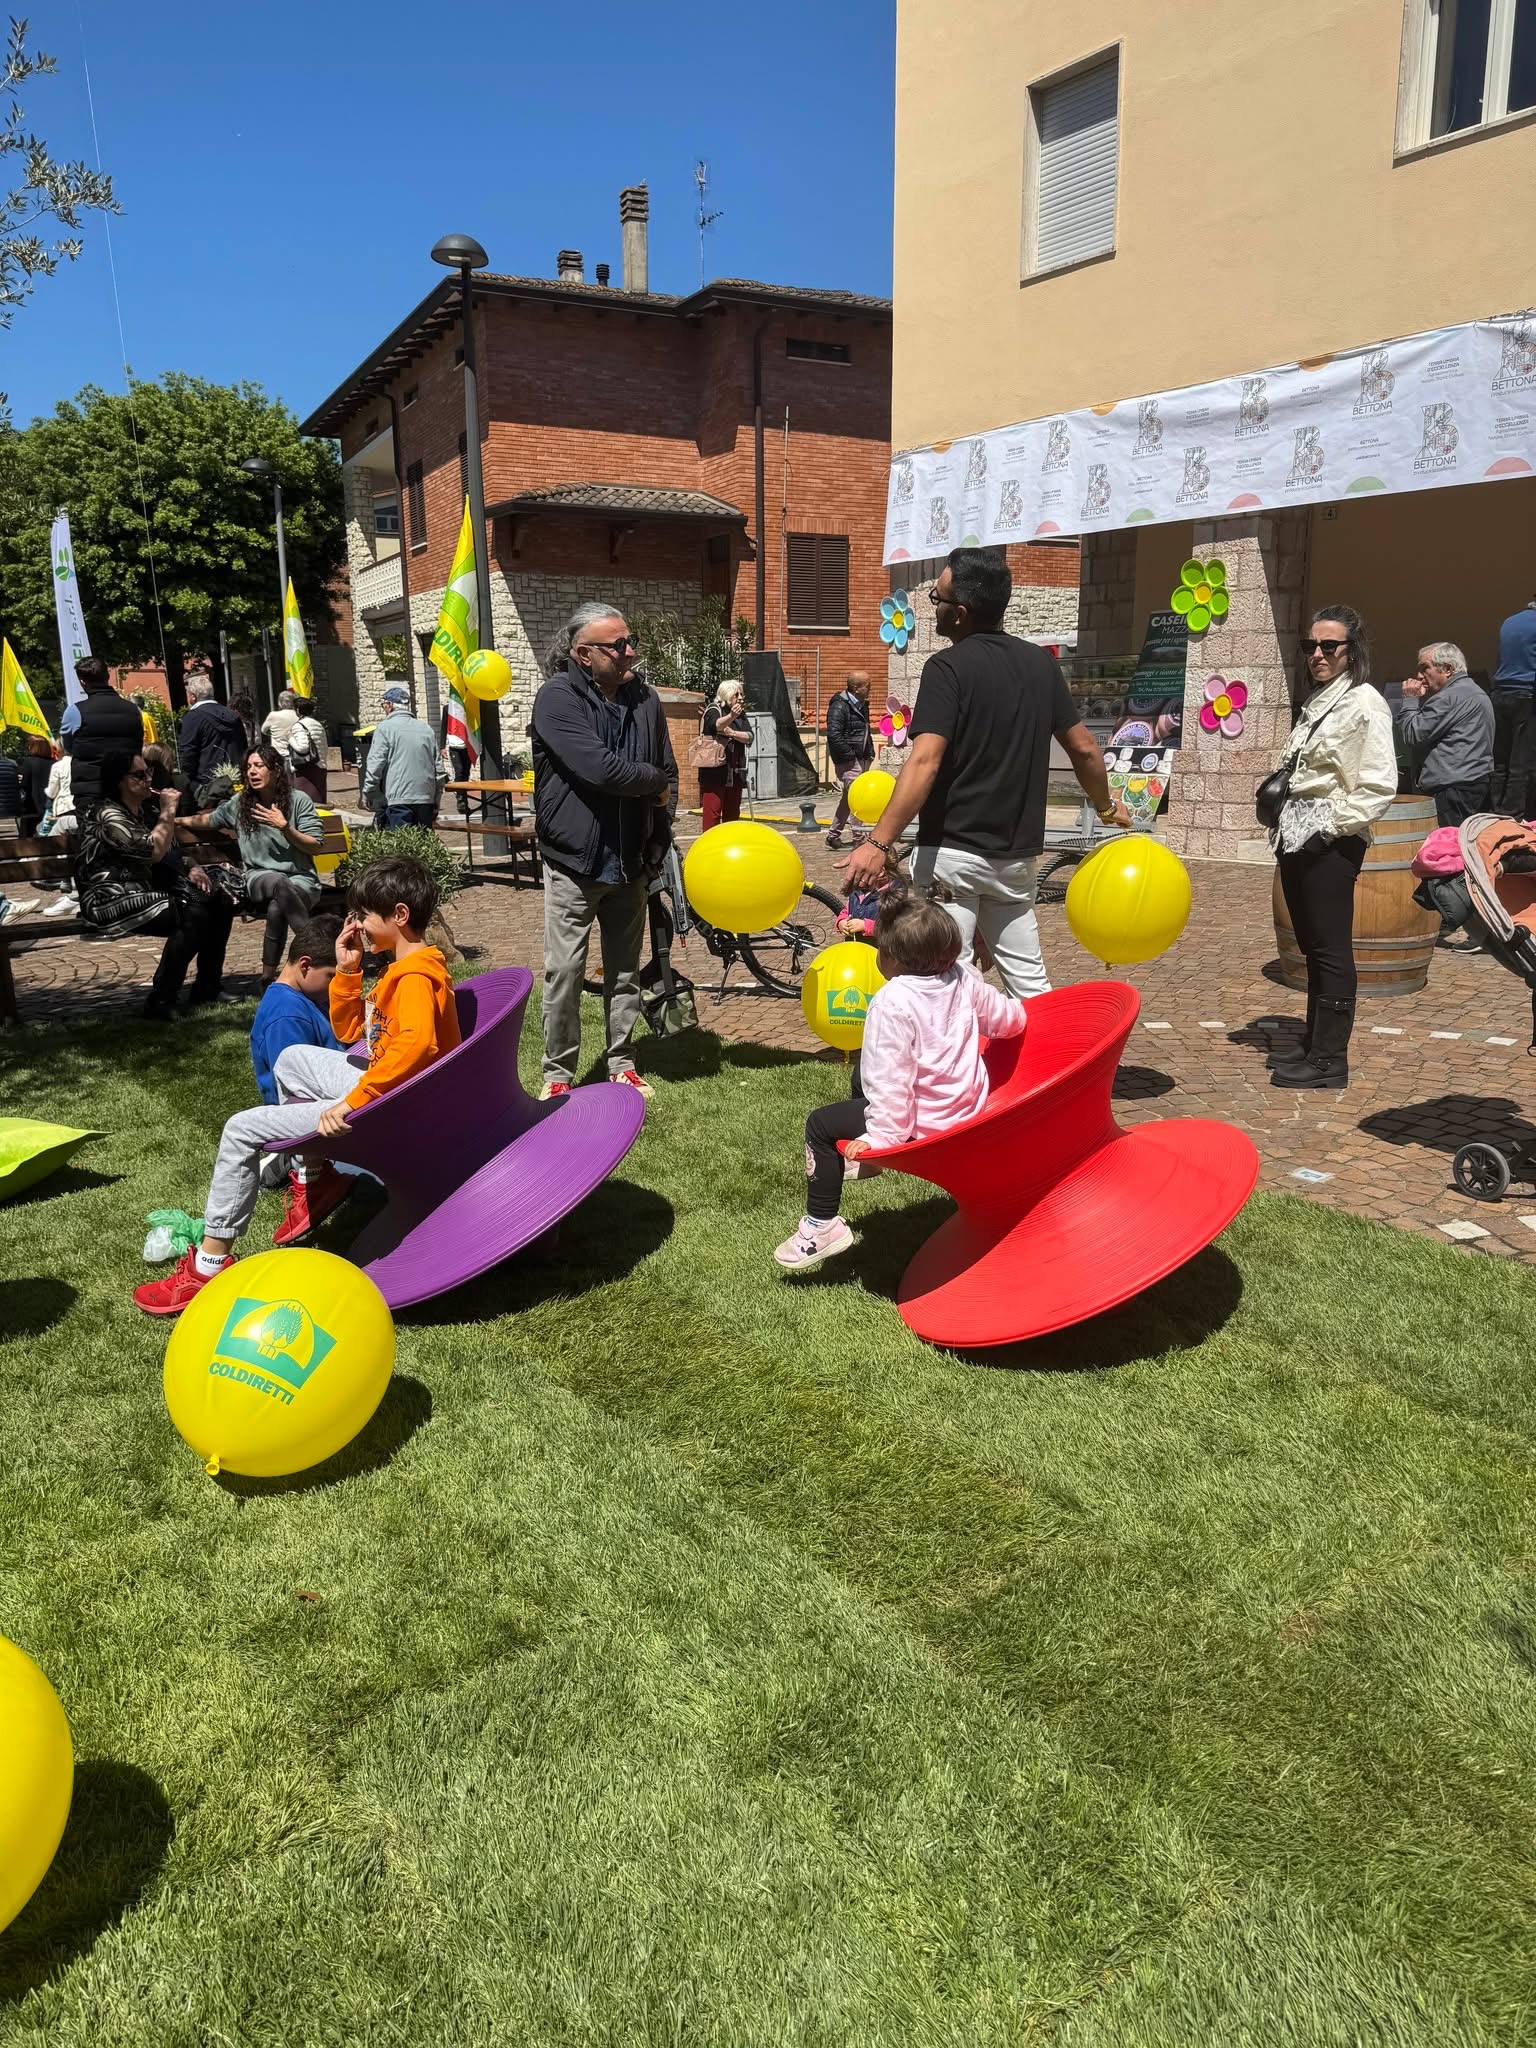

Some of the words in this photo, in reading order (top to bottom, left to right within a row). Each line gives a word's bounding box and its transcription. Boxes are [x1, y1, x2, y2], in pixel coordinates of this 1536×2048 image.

[1352, 400, 1393, 415] BETTONA
[1234, 423, 1270, 437] BETTONA
[1132, 443, 1163, 455] BETTONA
[1042, 460, 1069, 472] BETTONA
[1413, 455, 1457, 469] BETTONA
[1285, 474, 1323, 487] BETTONA
[1175, 491, 1209, 503] BETTONA
[1080, 506, 1110, 517] BETTONA
[994, 519, 1022, 529] BETTONA
[926, 534, 949, 544] BETTONA
[208, 1361, 295, 1406] COLDIRETTI
